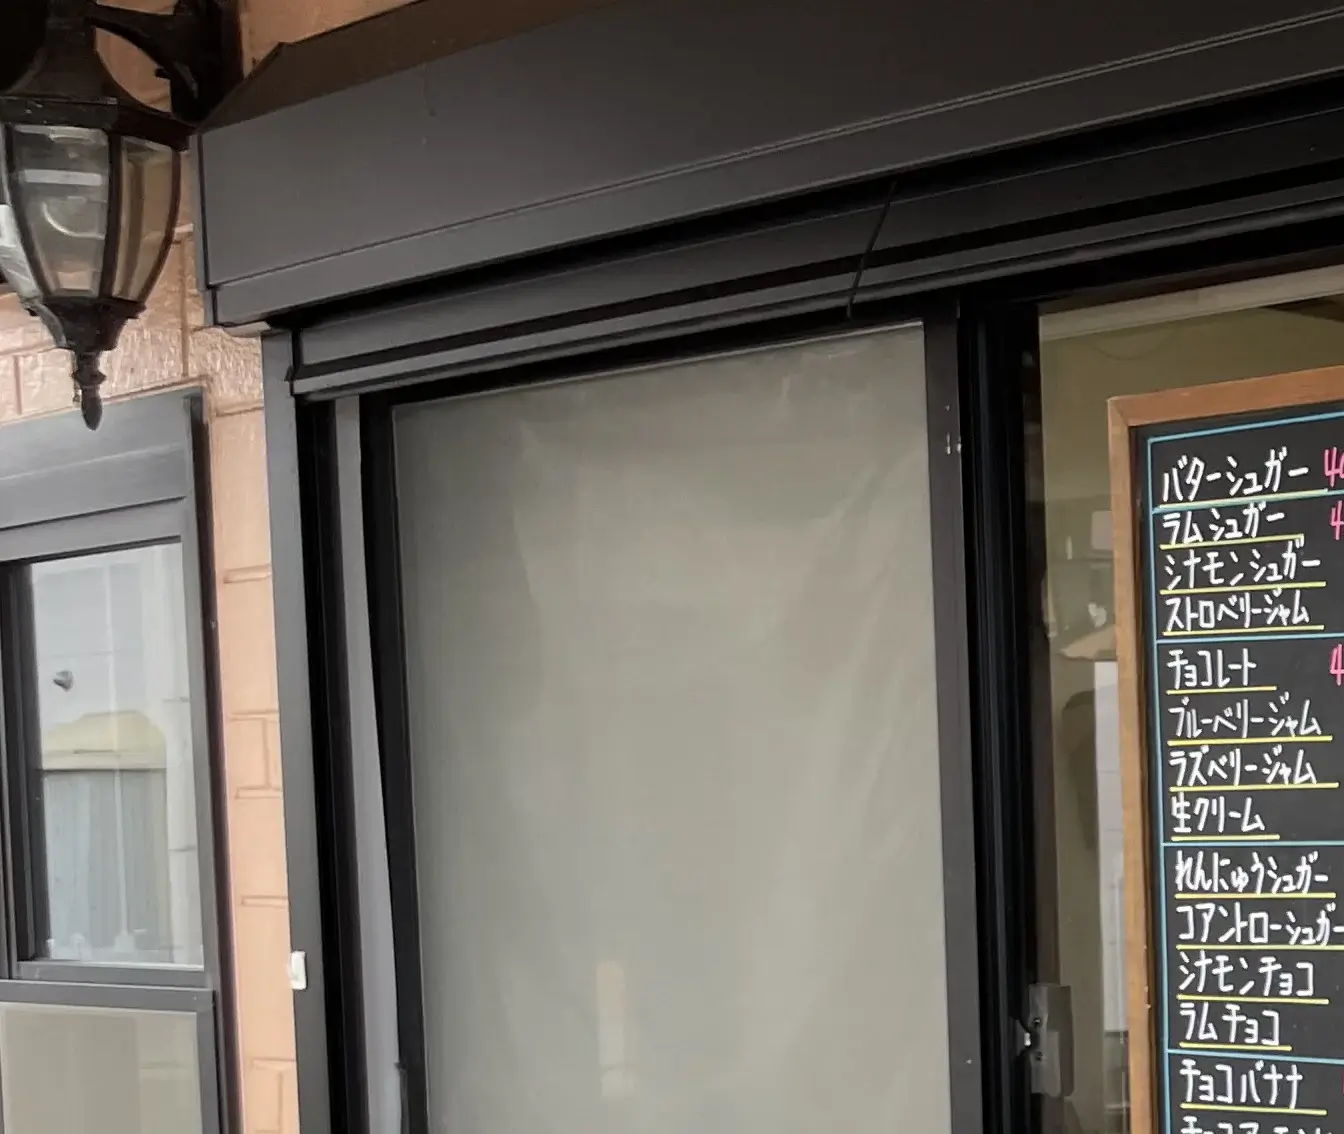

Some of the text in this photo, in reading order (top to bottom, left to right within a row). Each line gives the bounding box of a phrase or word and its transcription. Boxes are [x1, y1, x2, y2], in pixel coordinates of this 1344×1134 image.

[1163, 446, 1310, 501] バターシュガー
[1163, 502, 1284, 545] ラムシュガー
[1164, 536, 1321, 590] シナモンシュガー
[1164, 587, 1310, 630] ストロベリージャム
[1168, 648, 1256, 689] チョコレート
[1169, 692, 1321, 738] ブルーベリージャム
[1169, 745, 1317, 786] ラズベリージャム
[1172, 792, 1264, 833] 生クリーム
[1175, 850, 1328, 893] れんにゅうシュガー
[1179, 949, 1313, 997] シナモンチョコ
[1180, 1003, 1279, 1046] ラムチョコ
[1180, 1059, 1303, 1109] チョコバナナ
